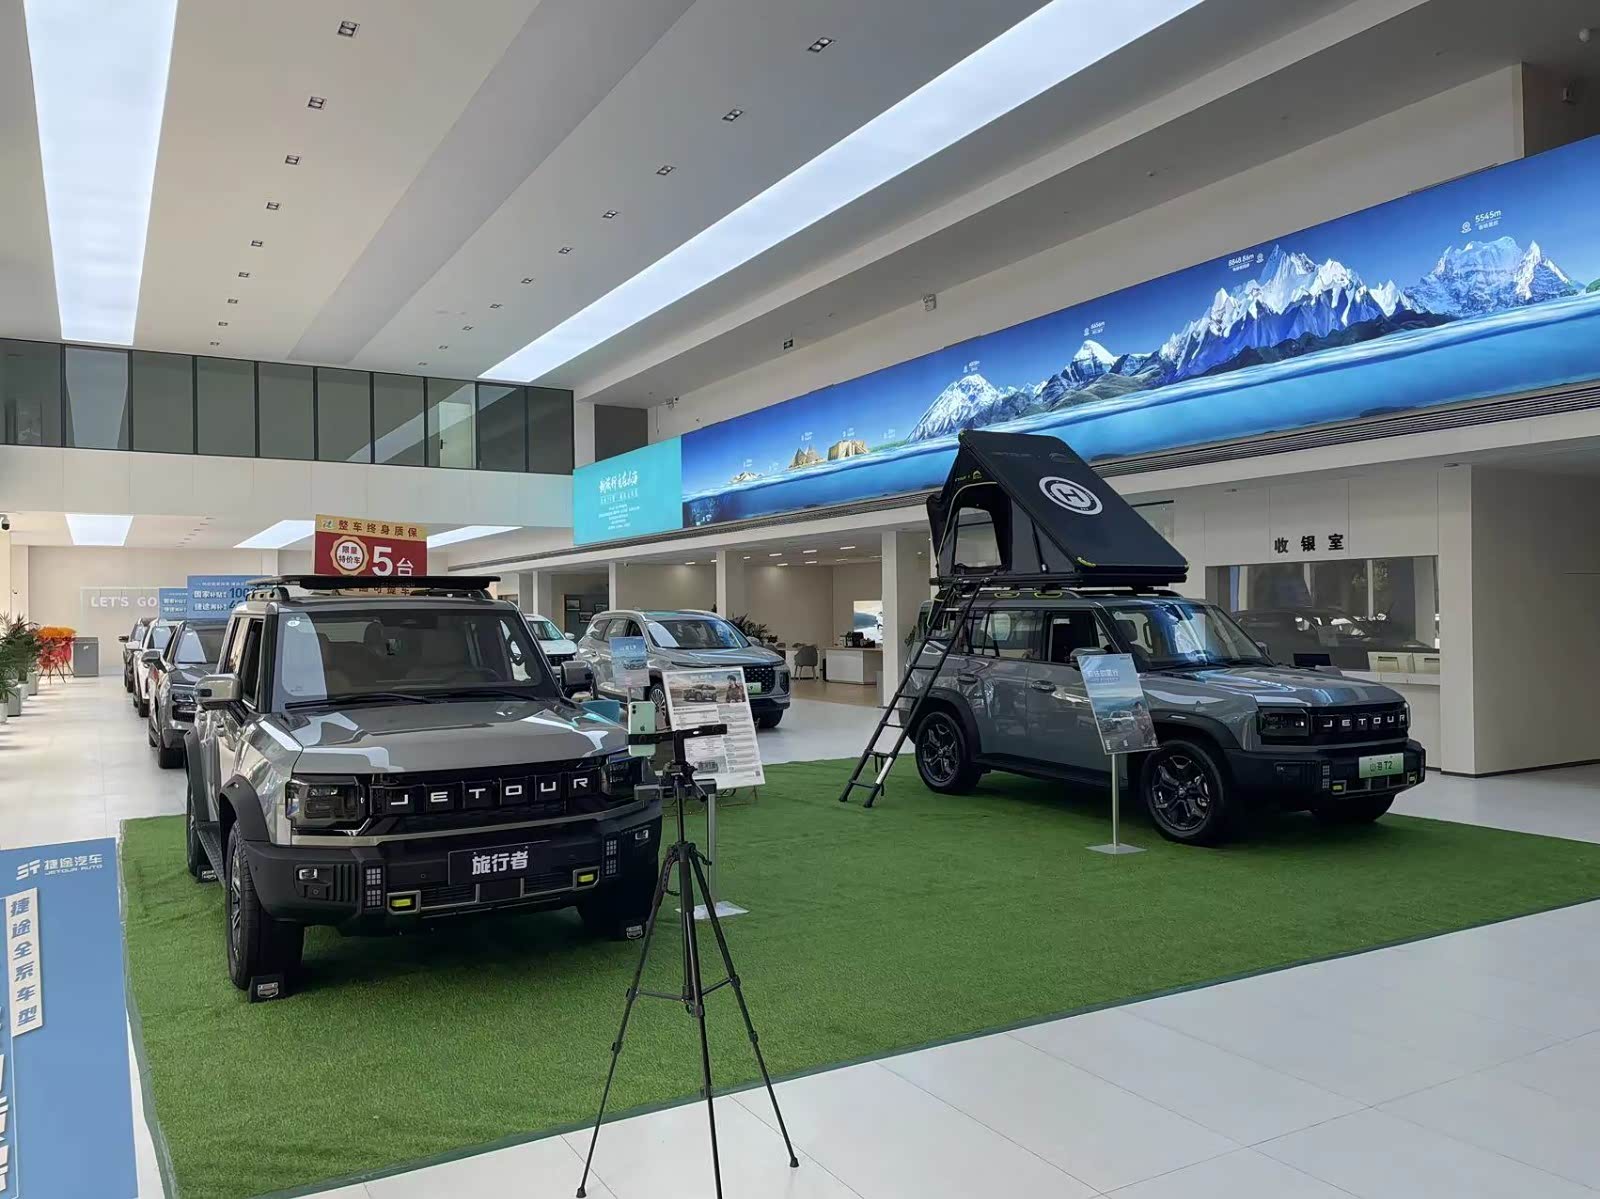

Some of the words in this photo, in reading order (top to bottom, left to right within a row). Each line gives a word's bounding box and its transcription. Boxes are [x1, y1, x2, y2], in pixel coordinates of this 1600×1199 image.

[1475, 210, 1502, 223] 5545m
[338, 519, 418, 538] 整车终身质保
[1274, 533, 1344, 554] 收银室
[338, 555, 361, 565] 特价车
[229, 587, 255, 598] 100
[91, 596, 129, 608] LET'S
[137, 596, 157, 608] GO
[1323, 714, 1405, 728] JETOUR
[1384, 760, 1393, 770] T2
[391, 777, 589, 806] JETOUR
[44, 853, 103, 871] 捷途汽车
[471, 850, 529, 875] 旅行者
[44, 866, 79, 876] JETOUR
[80, 863, 103, 872] AUTO
[10, 896, 38, 1027] 捷途全系车型
